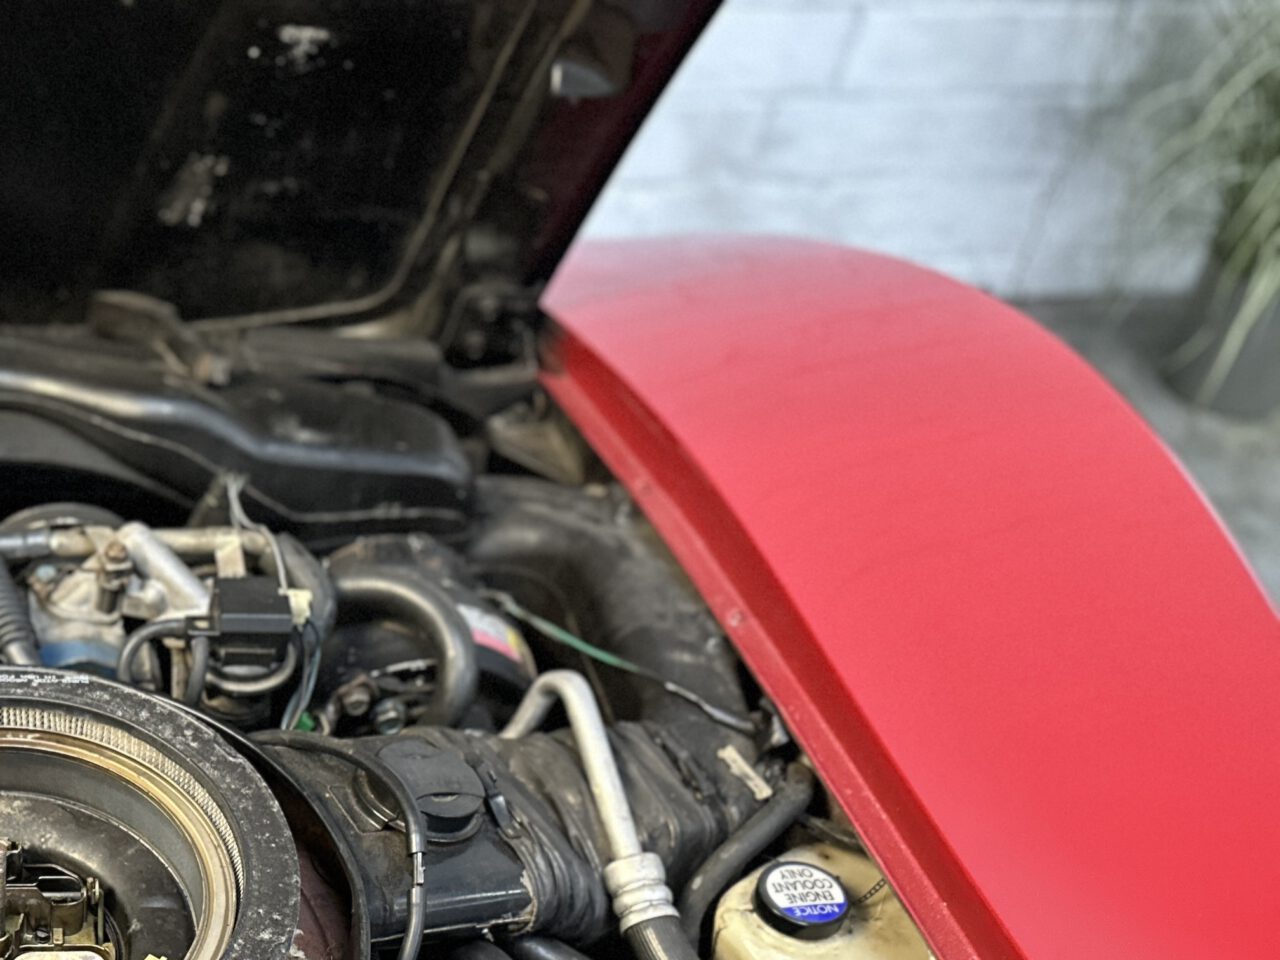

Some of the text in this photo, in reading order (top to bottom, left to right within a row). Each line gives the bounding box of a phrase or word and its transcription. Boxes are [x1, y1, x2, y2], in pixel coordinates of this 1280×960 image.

[779, 868, 814, 879] ONLY
[772, 879, 834, 893] COOLANT
[787, 890, 835, 904] ENGINE
[793, 904, 840, 916] NOTICE
